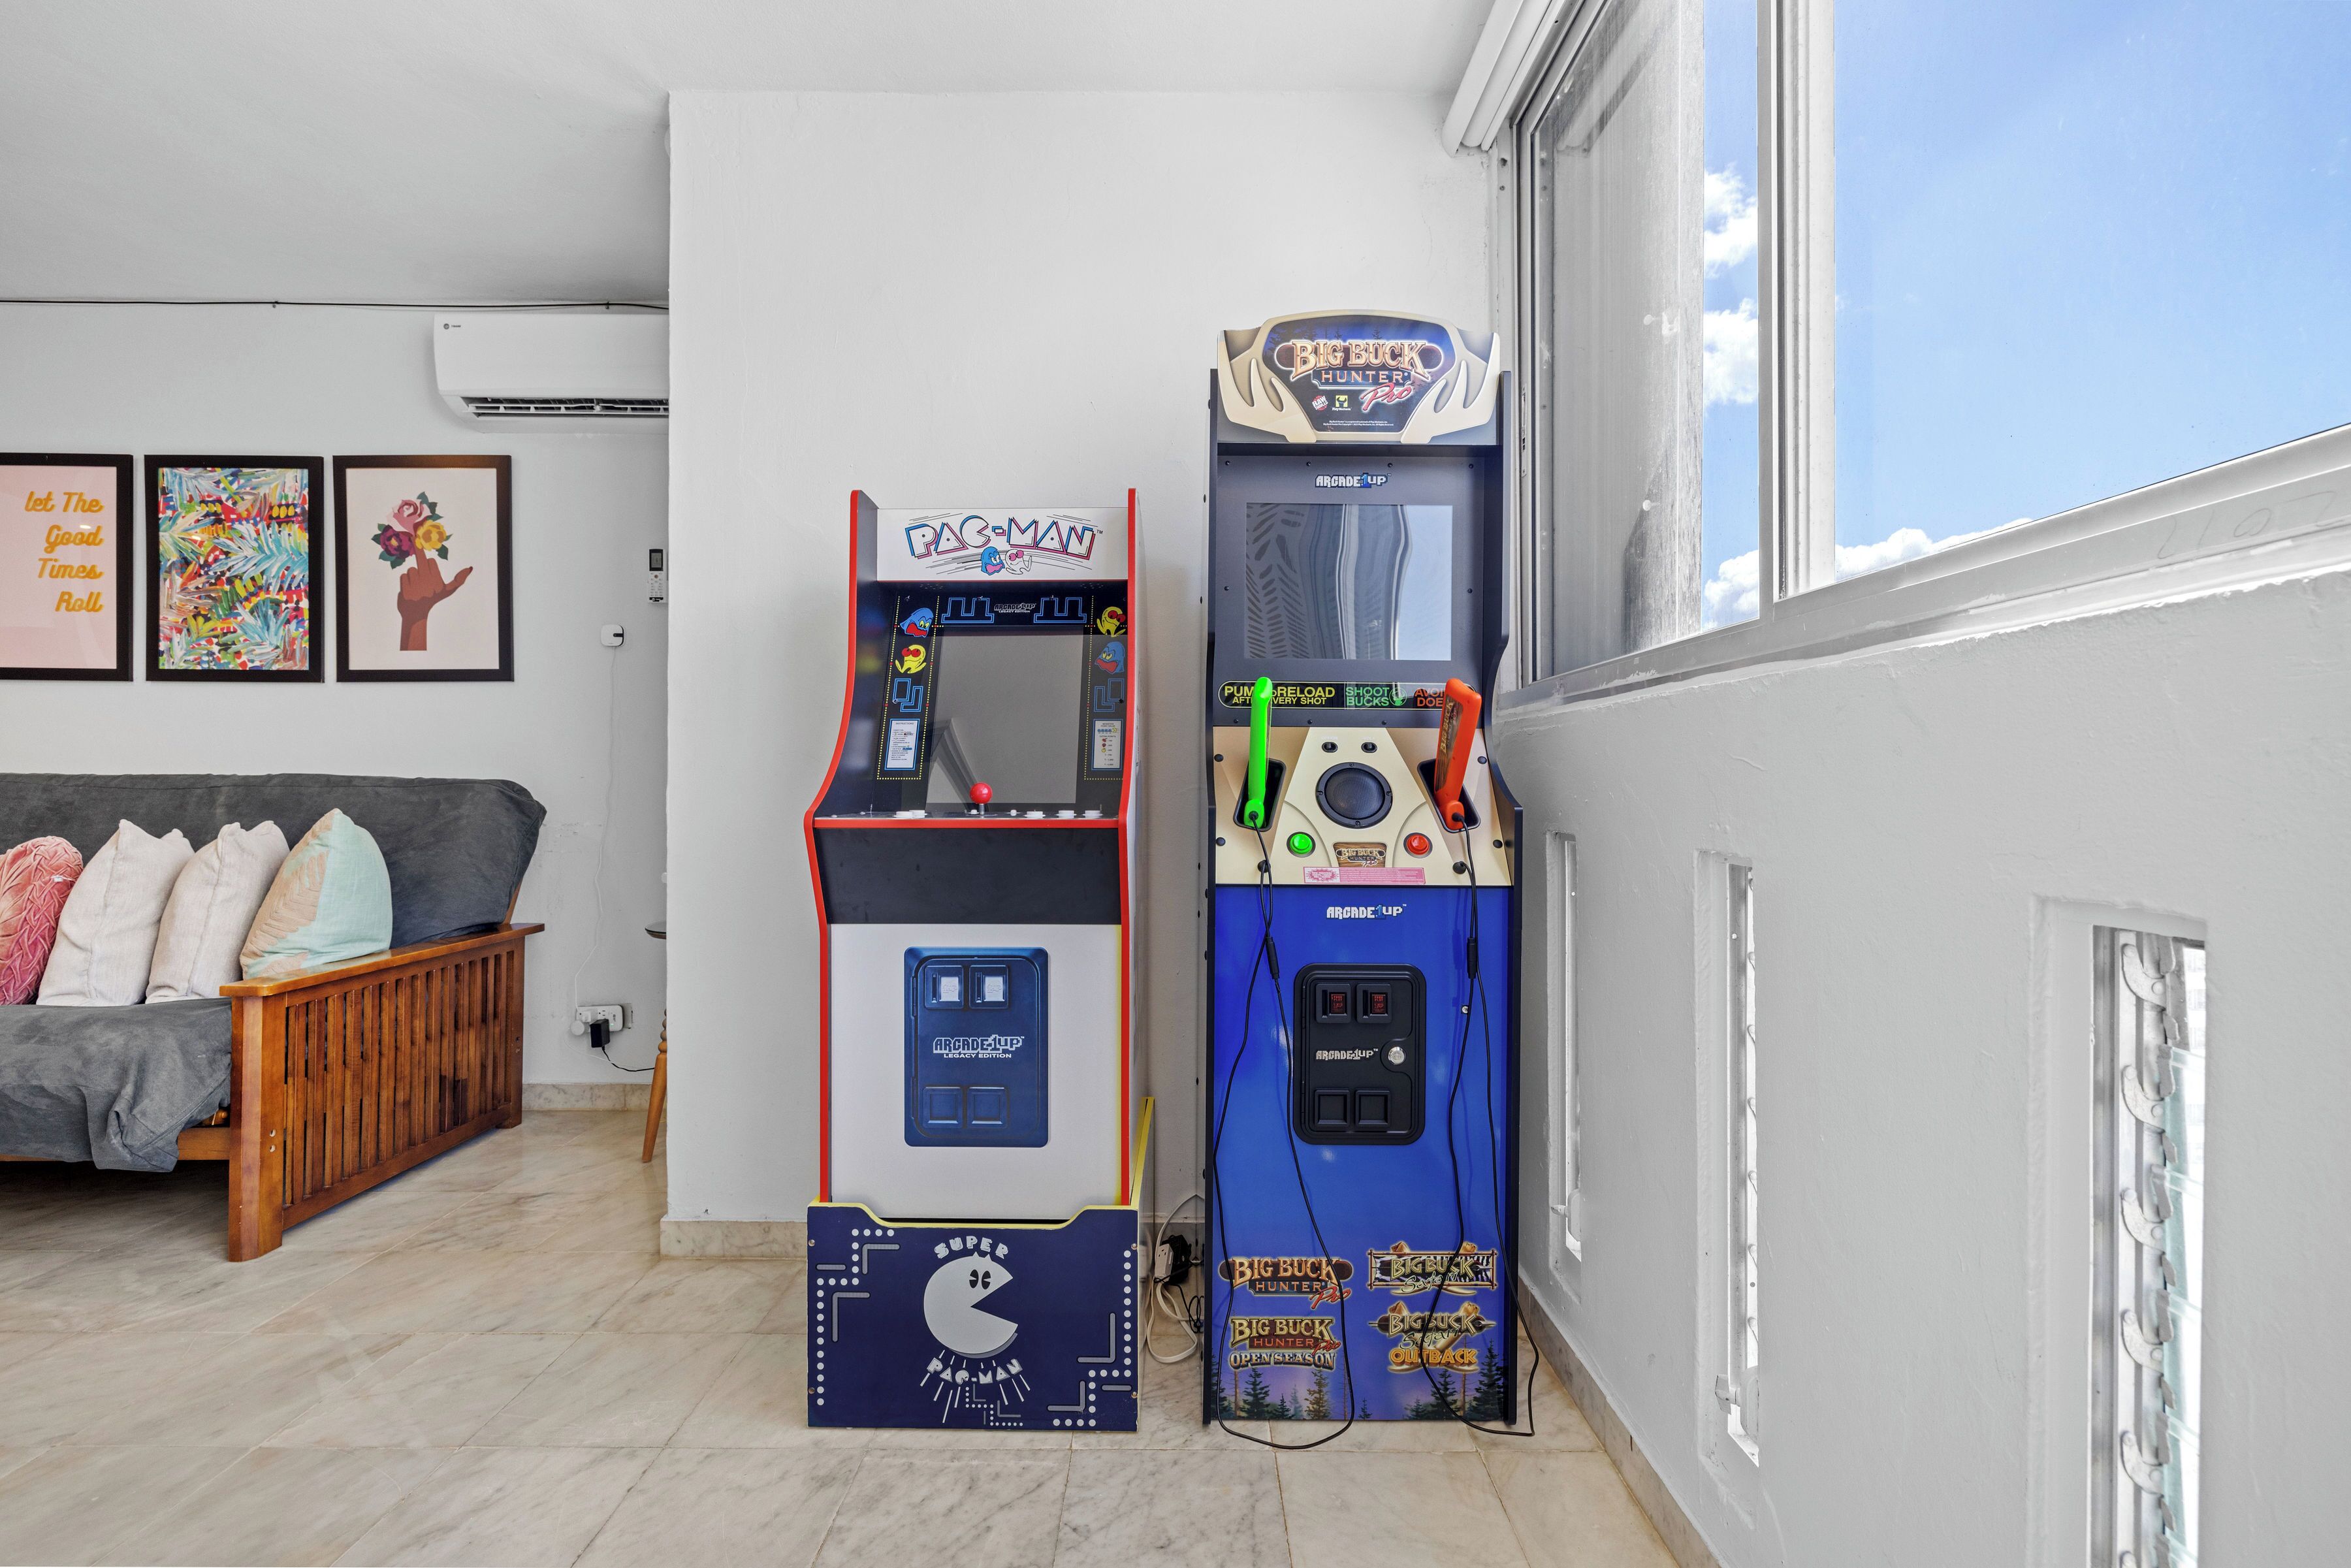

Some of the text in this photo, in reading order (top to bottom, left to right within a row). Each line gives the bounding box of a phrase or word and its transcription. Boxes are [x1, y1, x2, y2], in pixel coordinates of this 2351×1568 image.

[1292, 340, 1430, 380] BIG BUCK
[1321, 370, 1403, 383] HUNTER
[1360, 382, 1412, 411] Pro
[24, 491, 104, 513] let The
[44, 524, 104, 554] Good
[904, 515, 1096, 560] PAC-MAN
[38, 558, 104, 580] Times
[55, 591, 104, 613] Roll
[1224, 686, 1255, 696] PUM
[1277, 686, 1335, 697] RELOAD
[1345, 686, 1390, 696] SHOOT
[1347, 696, 1390, 706] BUCKS
[1415, 688, 1443, 697] AVOI
[1417, 697, 1443, 707] DOE
[1341, 848, 1383, 860] BIG BUCK
[935, 1236, 1009, 1260] SUPER
[1232, 1258, 1341, 1288] BIG BUCK
[1390, 1257, 1475, 1281] BIG BUCK
[1255, 1281, 1322, 1291] HUNTER
[1309, 1285, 1351, 1309] Pro
[1231, 1319, 1335, 1348] BIG BUCK
[1388, 1313, 1422, 1337] BIG
[1254, 1338, 1314, 1347] HUNTER
[1311, 1339, 1341, 1356] Pro
[1230, 1352, 1335, 1370] OPEN SEASON
[1390, 1349, 1478, 1365] OUTBACK
[927, 1358, 1023, 1384] PAC-MAN
